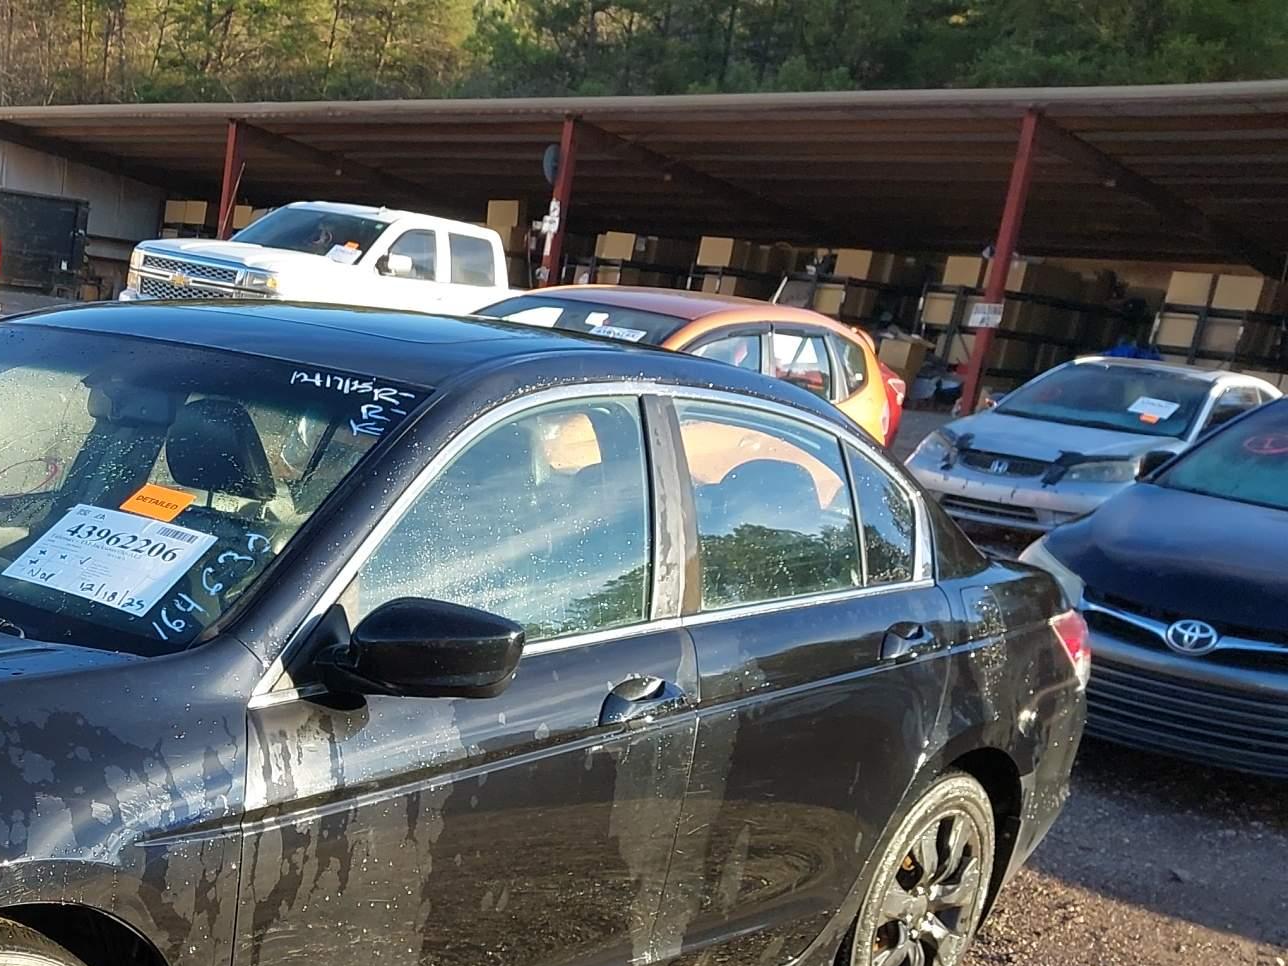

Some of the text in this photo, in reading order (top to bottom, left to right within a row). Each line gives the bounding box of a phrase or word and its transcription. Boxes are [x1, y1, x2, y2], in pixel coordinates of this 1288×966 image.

[135, 494, 179, 511] DETAILED
[65, 522, 184, 562] 43962206
[79, 581, 146, 611] 12/18/25
